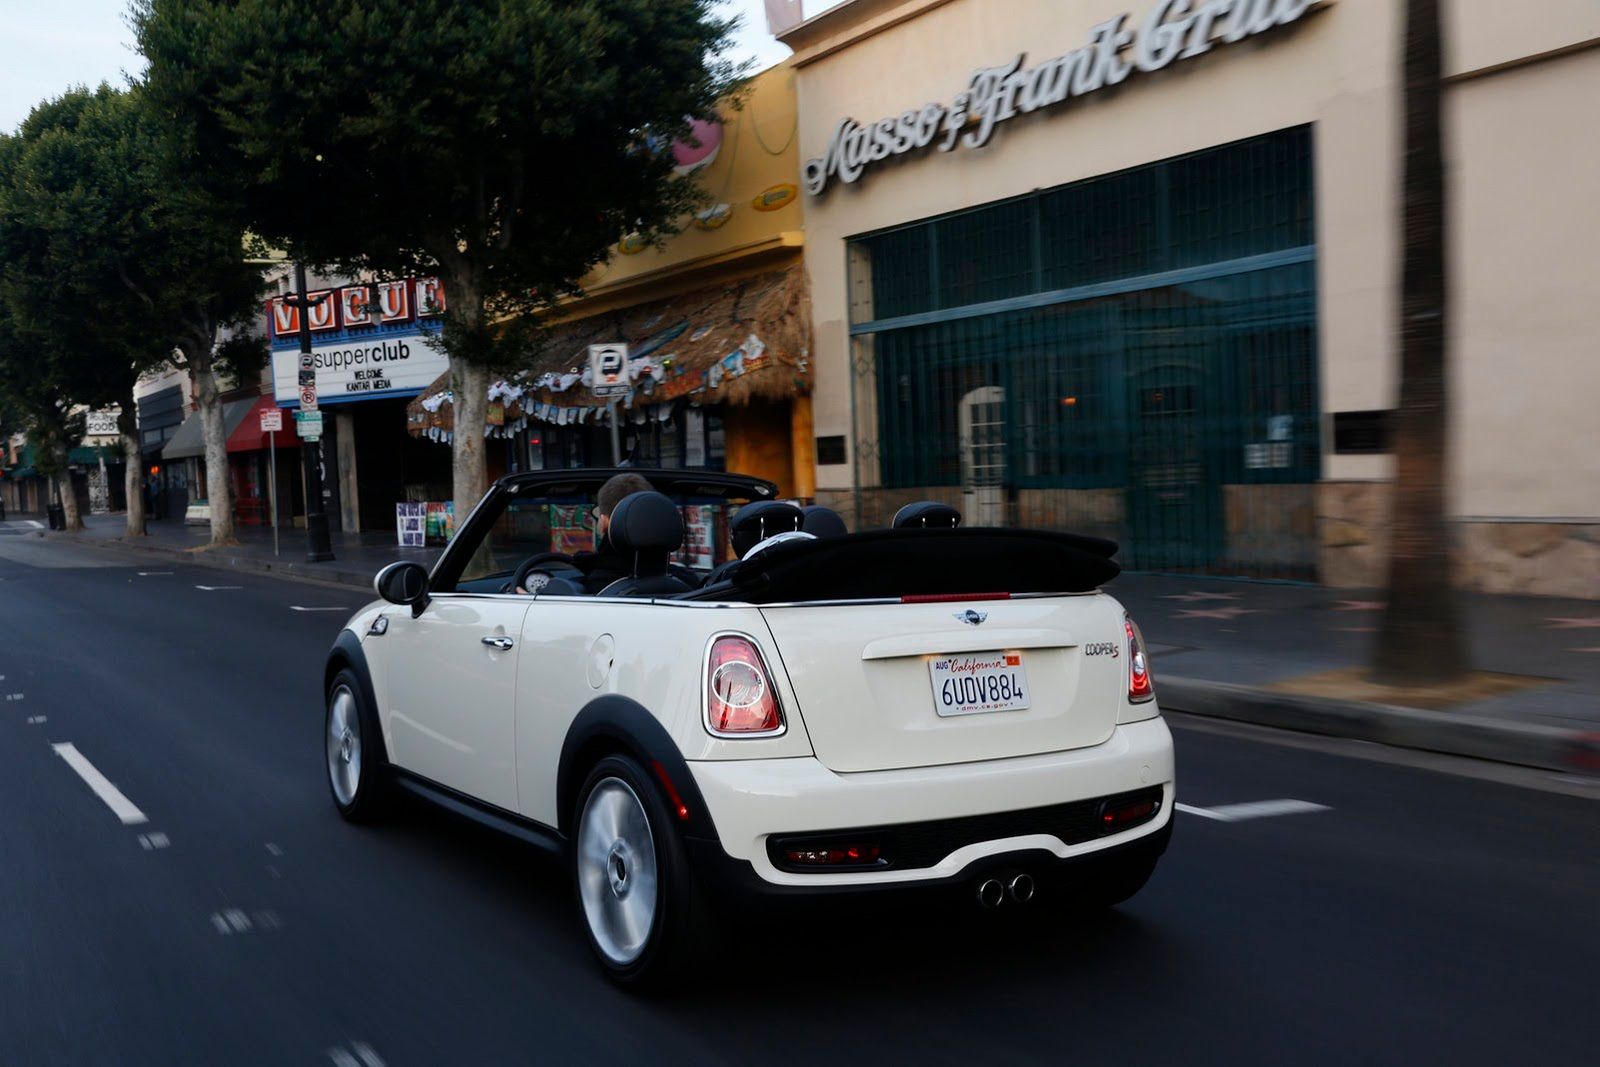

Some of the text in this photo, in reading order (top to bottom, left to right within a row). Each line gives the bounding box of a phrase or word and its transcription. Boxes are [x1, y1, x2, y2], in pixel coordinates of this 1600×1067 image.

[802, 103, 945, 195] Musso
[962, 15, 1135, 149] Frank
[273, 278, 441, 330] VOGUE
[314, 340, 410, 371] supperclub
[354, 369, 384, 379] WELCOME
[346, 379, 391, 392] KANTAR MEDIA
[936, 661, 949, 670] AUG
[950, 658, 1002, 675] California
[961, 702, 1009, 712] dmv.ca.gov
